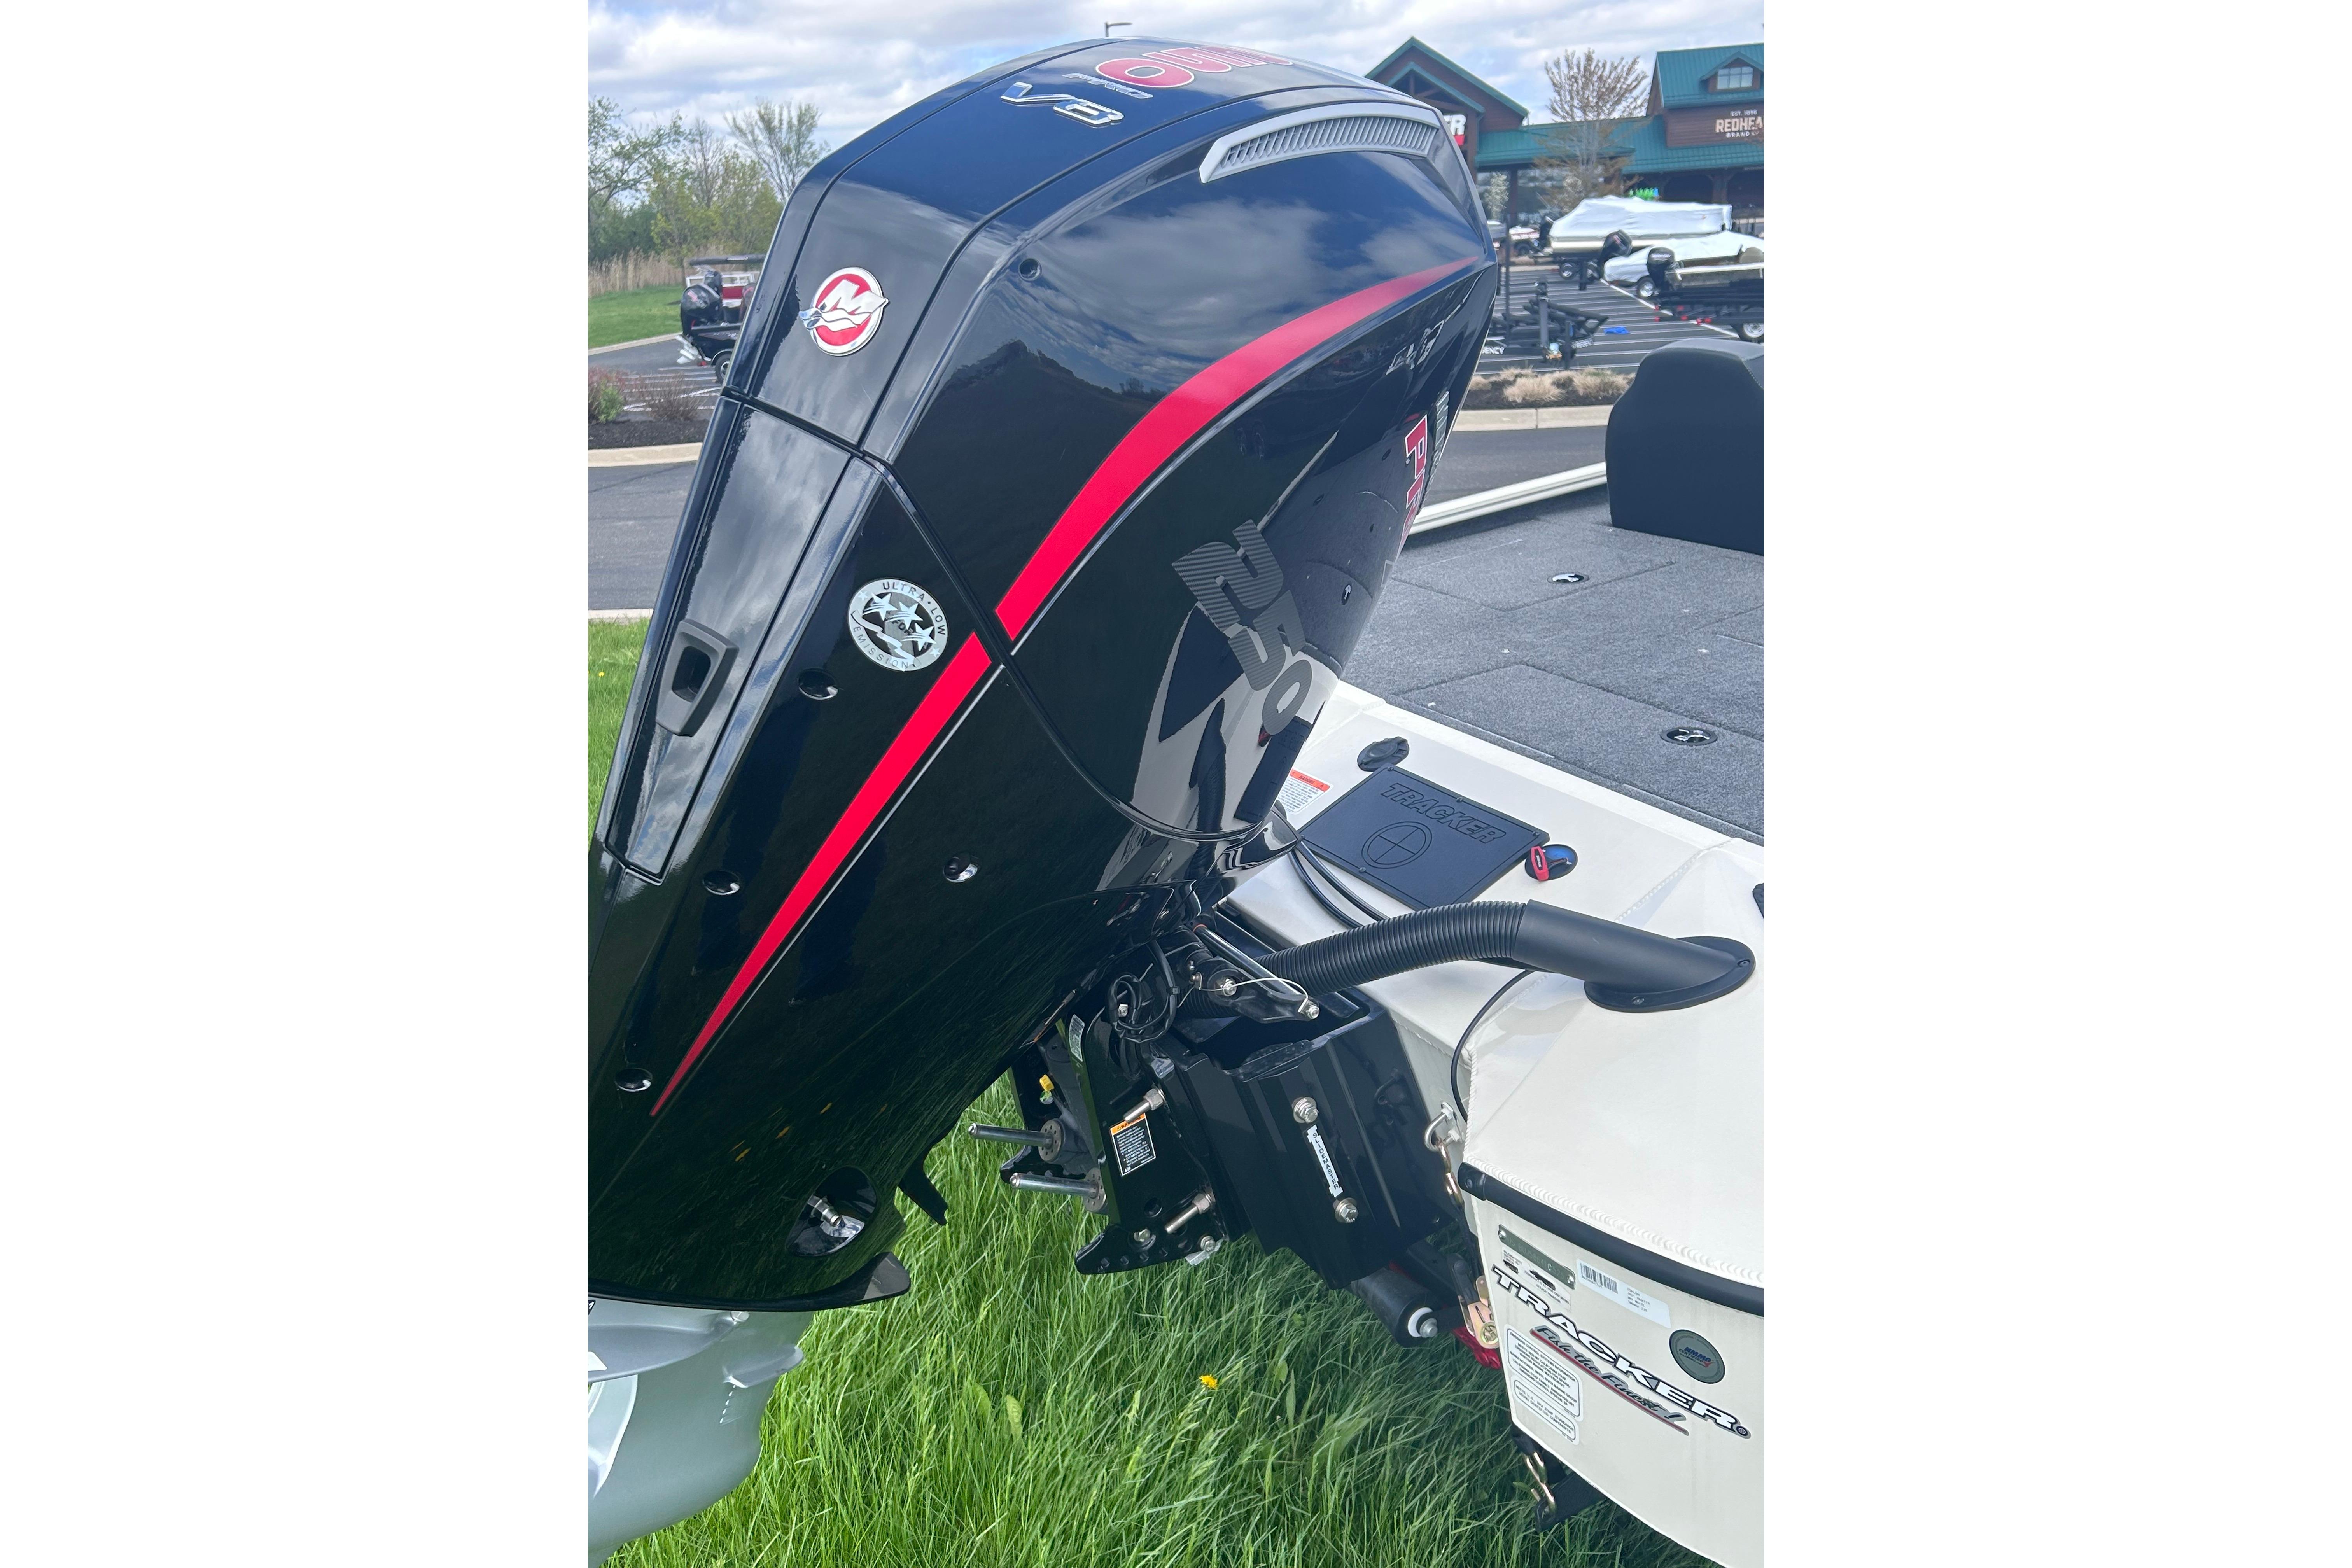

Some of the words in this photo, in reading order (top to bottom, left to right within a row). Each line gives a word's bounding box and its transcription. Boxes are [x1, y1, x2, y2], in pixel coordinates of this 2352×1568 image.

[1715, 117, 1763, 133] REDHEA
[882, 581, 925, 602] ULTRA
[931, 607, 946, 635] LOW
[1172, 519, 1313, 735] 250
[1380, 782, 1507, 844] TRACKER
[1312, 1132, 1339, 1189] SLIDEMASTER
[1537, 1328, 1573, 1355] Fish
[1573, 1353, 1600, 1376] the
